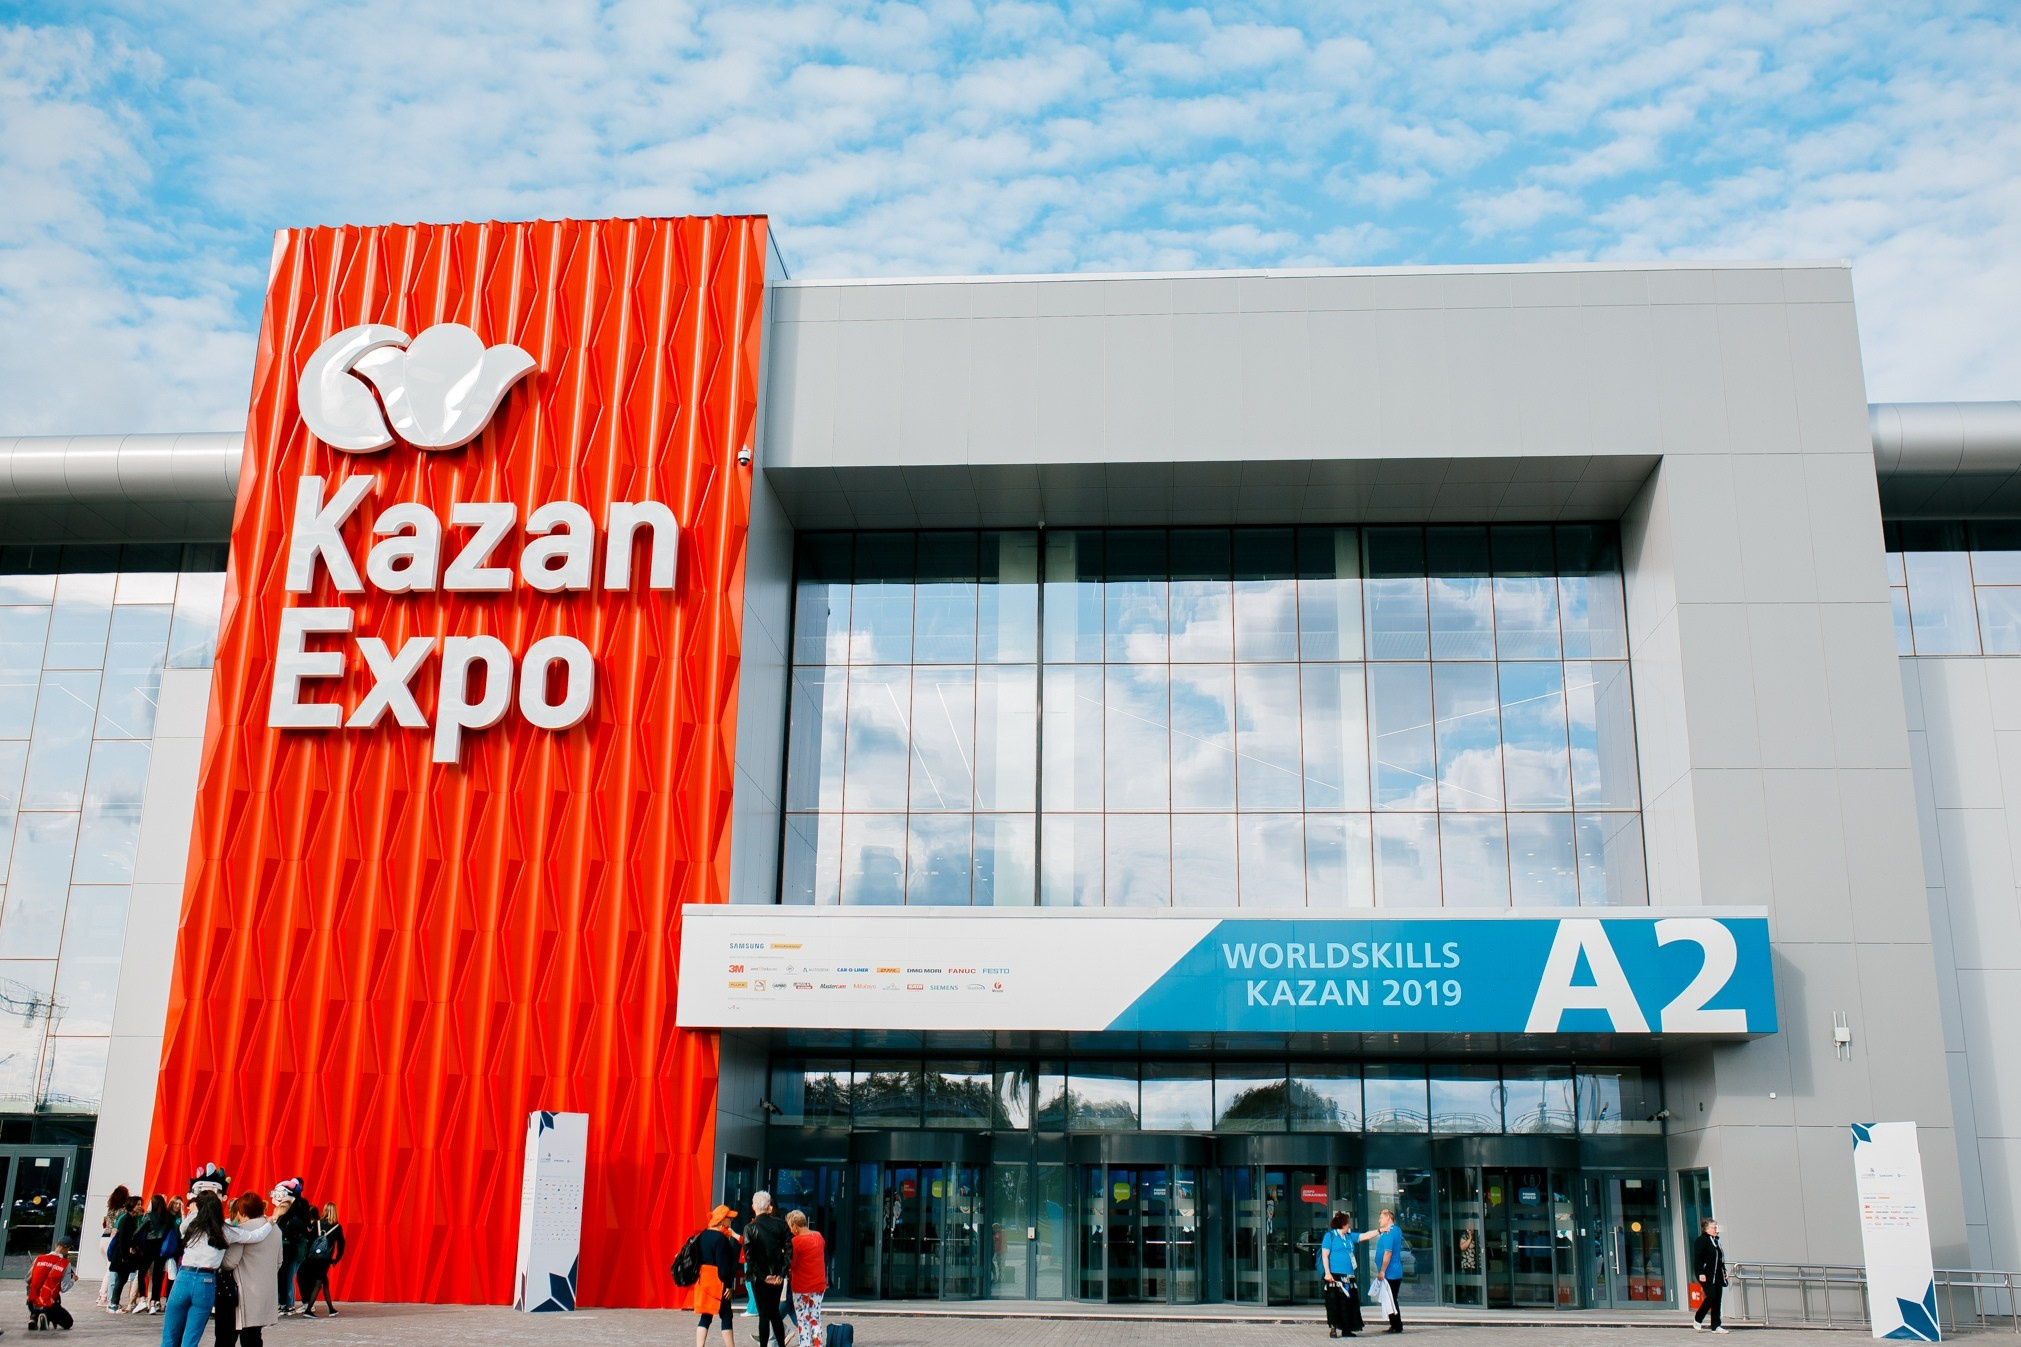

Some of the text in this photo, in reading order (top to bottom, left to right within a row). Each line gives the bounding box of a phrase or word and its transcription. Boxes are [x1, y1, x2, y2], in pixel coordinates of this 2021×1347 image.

[285, 474, 679, 594] Kazan
[268, 607, 595, 763] Expo
[728, 965, 744, 973] 3M
[1222, 941, 1460, 970] WORLDSKILLS
[1525, 917, 1748, 1034] A2
[1246, 979, 1462, 1007] KAZAN 2019
